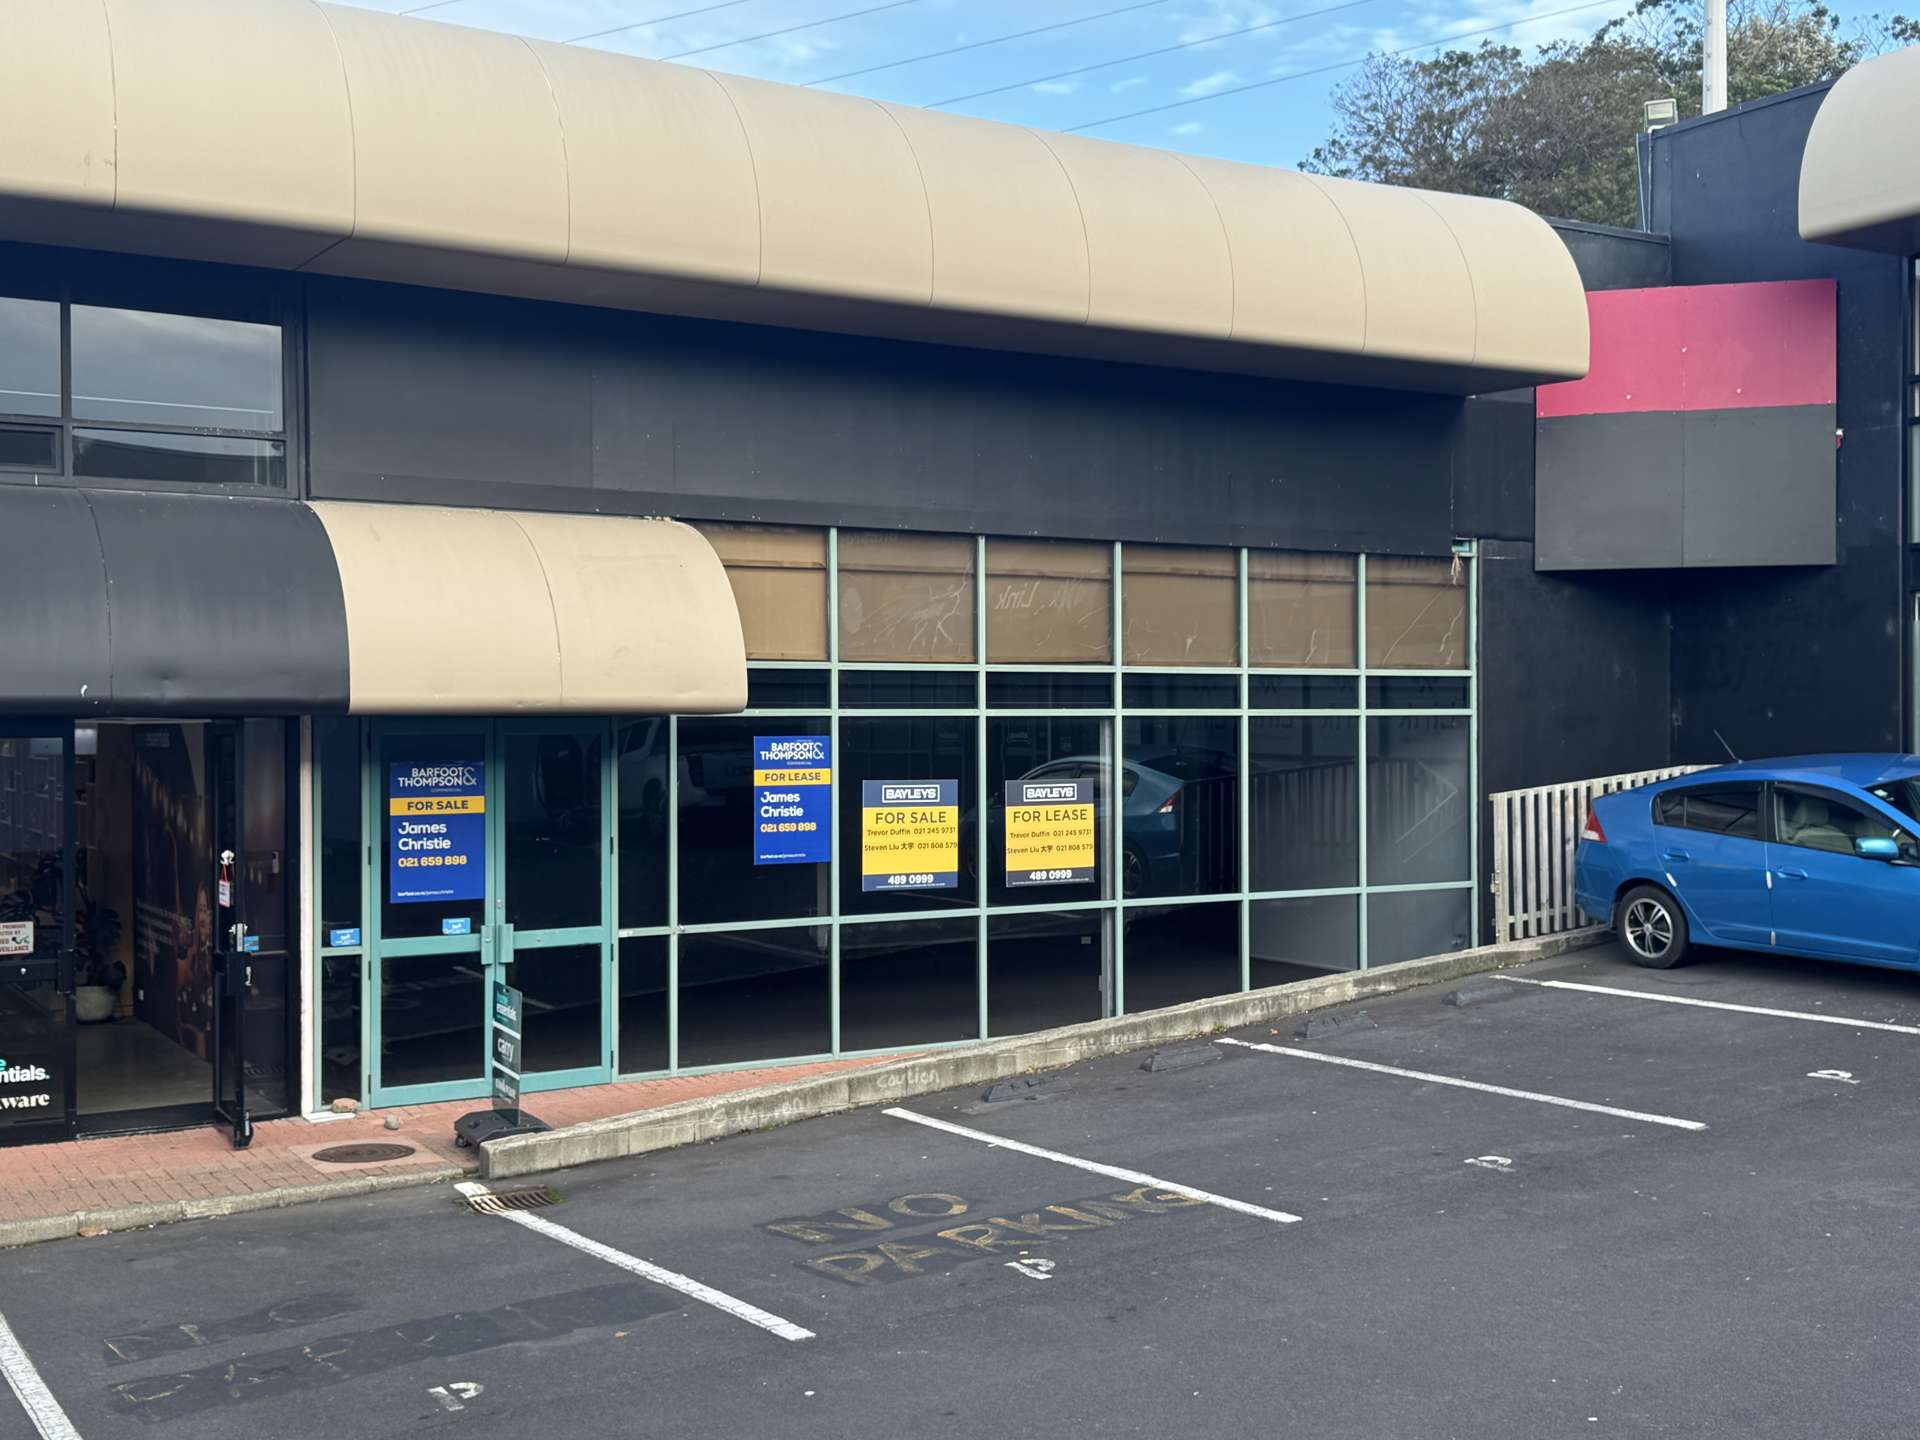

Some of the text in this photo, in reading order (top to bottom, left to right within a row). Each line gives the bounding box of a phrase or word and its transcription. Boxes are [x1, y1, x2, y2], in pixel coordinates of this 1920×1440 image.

[760, 751, 813, 760] THOMPSON
[398, 776, 463, 787] THOMPSON
[764, 772, 821, 782] FOR LEASE
[760, 791, 801, 803] James
[885, 788, 937, 800] BAYLEYS
[1026, 787, 1074, 798] BAYLEYS
[407, 800, 469, 811] FOR SALE
[760, 805, 804, 818] Christie
[1013, 809, 1088, 823] FOR LEASE
[875, 811, 947, 824] FOR SALE
[398, 821, 447, 835] James
[760, 823, 777, 832] 021
[778, 822, 797, 832] 659
[867, 829, 889, 837] Trevor
[890, 828, 911, 836] Duffin
[1010, 831, 1030, 839] Trevor
[1065, 829, 1077, 837] 245
[398, 837, 452, 850] Christie
[888, 843, 900, 851] Liu
[398, 857, 419, 867] 021
[420, 856, 443, 866] 659
[888, 874, 934, 885] 489 0999
[1029, 869, 1073, 881] 489 0999
[766, 1192, 969, 1243] NO
[806, 1187, 1209, 1286] PARKING
